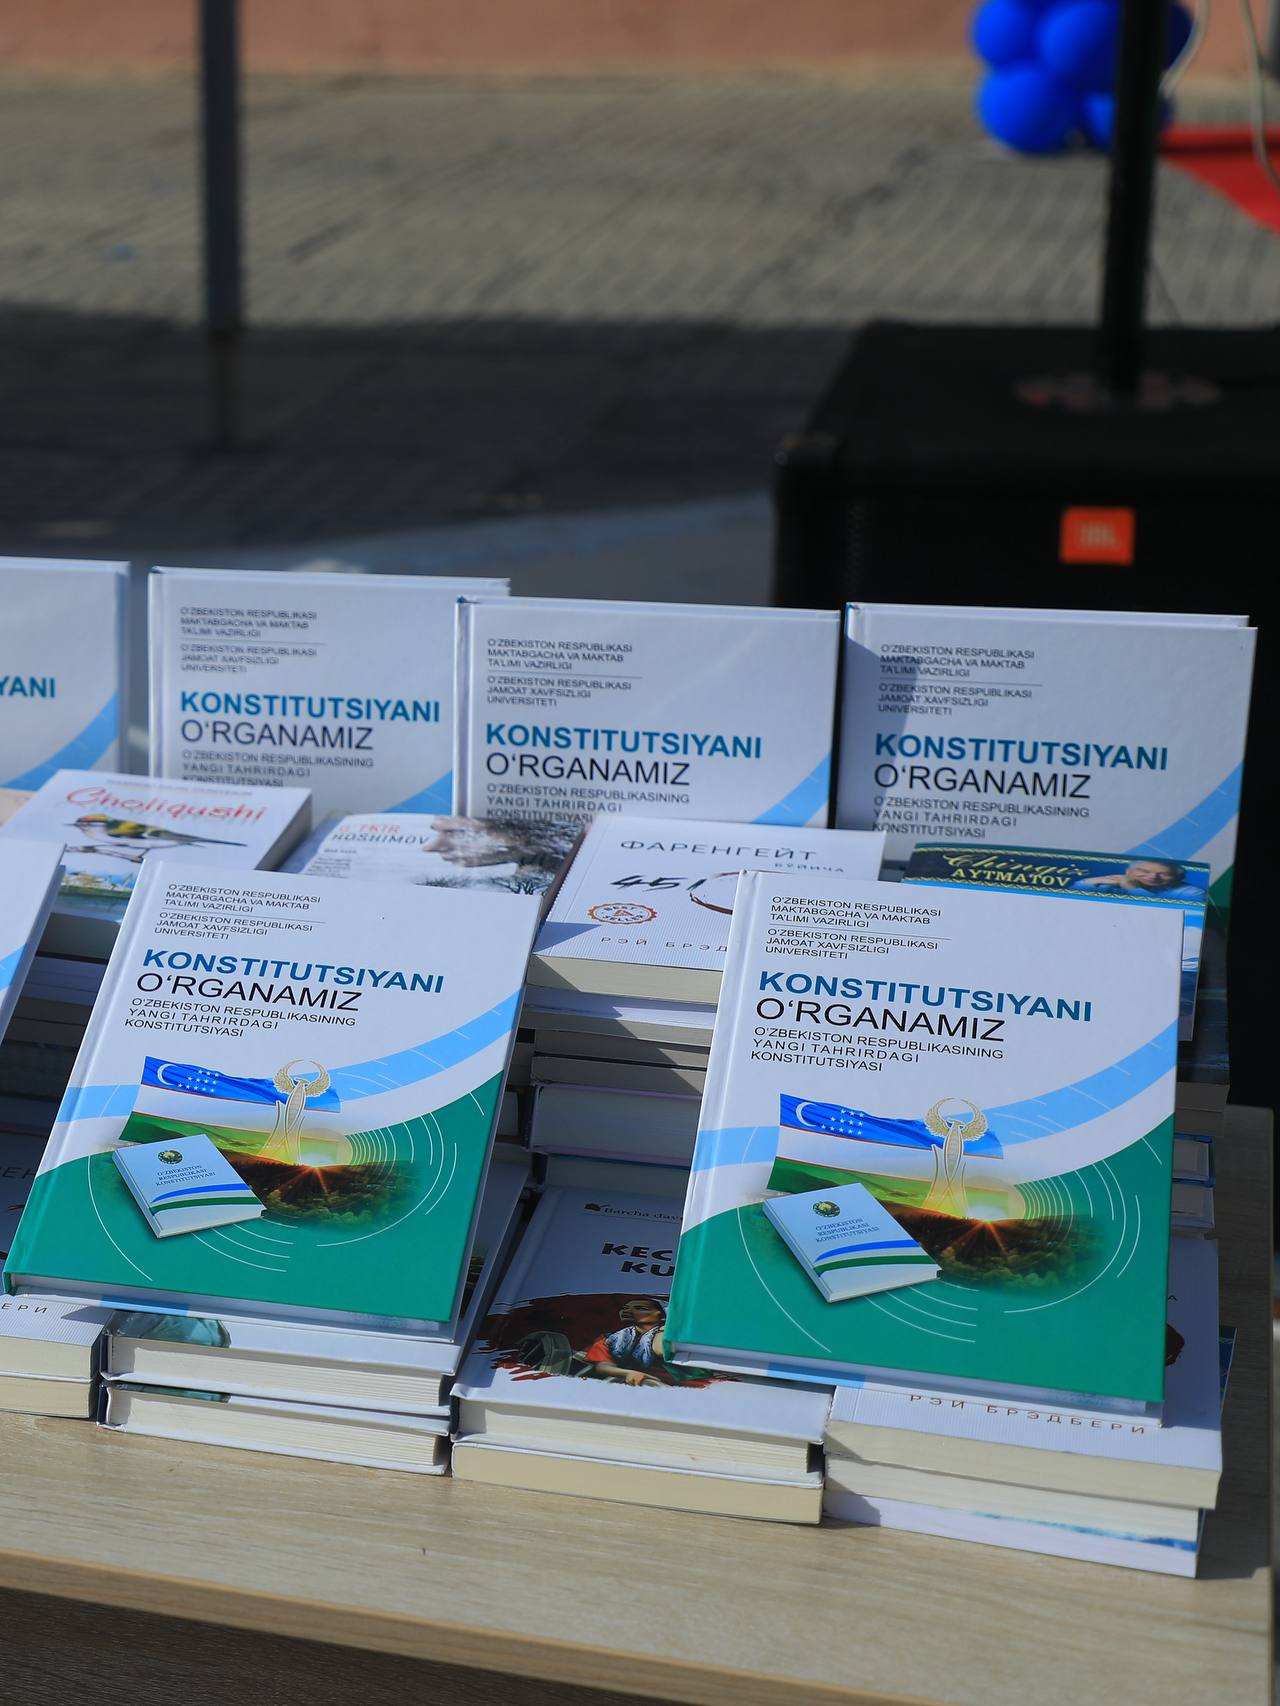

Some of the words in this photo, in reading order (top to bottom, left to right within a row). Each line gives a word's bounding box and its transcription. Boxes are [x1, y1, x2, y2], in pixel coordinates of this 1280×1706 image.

[180, 691, 440, 724] KONSTITUTSIYANI
[486, 723, 762, 761] KONSTITUTSIYANI
[875, 733, 1168, 772] KONSTITUTSIYANI
[66, 786, 268, 822] Choliqushi
[332, 832, 430, 845] HOSHIMOV
[620, 840, 817, 861] ФАРЕНГЕЙТ
[951, 868, 1071, 887] AYTMATOV
[165, 891, 248, 905] MAKTABGACHA
[249, 898, 264, 906] VA
[264, 899, 311, 910] MAKTAB
[241, 889, 322, 903] RESPUBLIKASI
[201, 901, 254, 913] VAZIRLIGI
[770, 904, 862, 919] MAKTABGACHA
[863, 911, 880, 921] VA
[881, 913, 931, 925] MAKTAB
[853, 902, 942, 917] RESPUBLIKASI
[155, 920, 201, 930] JAMOAT
[201, 923, 268, 936] XAVFSIZLIGI
[233, 918, 314, 932] RESPUBLIKASI
[811, 916, 870, 929] VAZIRLIGI
[153, 927, 230, 940] UNIVERSITETI
[850, 934, 939, 951] RESPUBLIKASI
[764, 945, 849, 960] UNIVERSITETI
[765, 937, 815, 948] JAMOAT
[816, 940, 890, 955] XAVFSIZLIGI
[142, 949, 445, 995] KONSTITUTSIYANI
[758, 970, 1092, 1023] KONSTITUTSIYANI
[128, 1007, 177, 1021] YANGI
[181, 1012, 279, 1030] TAHRIRDAGI
[223, 1005, 356, 1027] RESPUBLIKASINING
[124, 1018, 244, 1038] KONSTITUTSIYASI
[752, 1038, 806, 1053] YANGI
[810, 1043, 919, 1064] TAHRIRDAGI
[856, 1035, 1004, 1060] RESPUBLIKASINING
[750, 1050, 883, 1072] KONSTITUTSIYASI
[986, 1405, 1146, 1435] БРЭДБЕРИ
